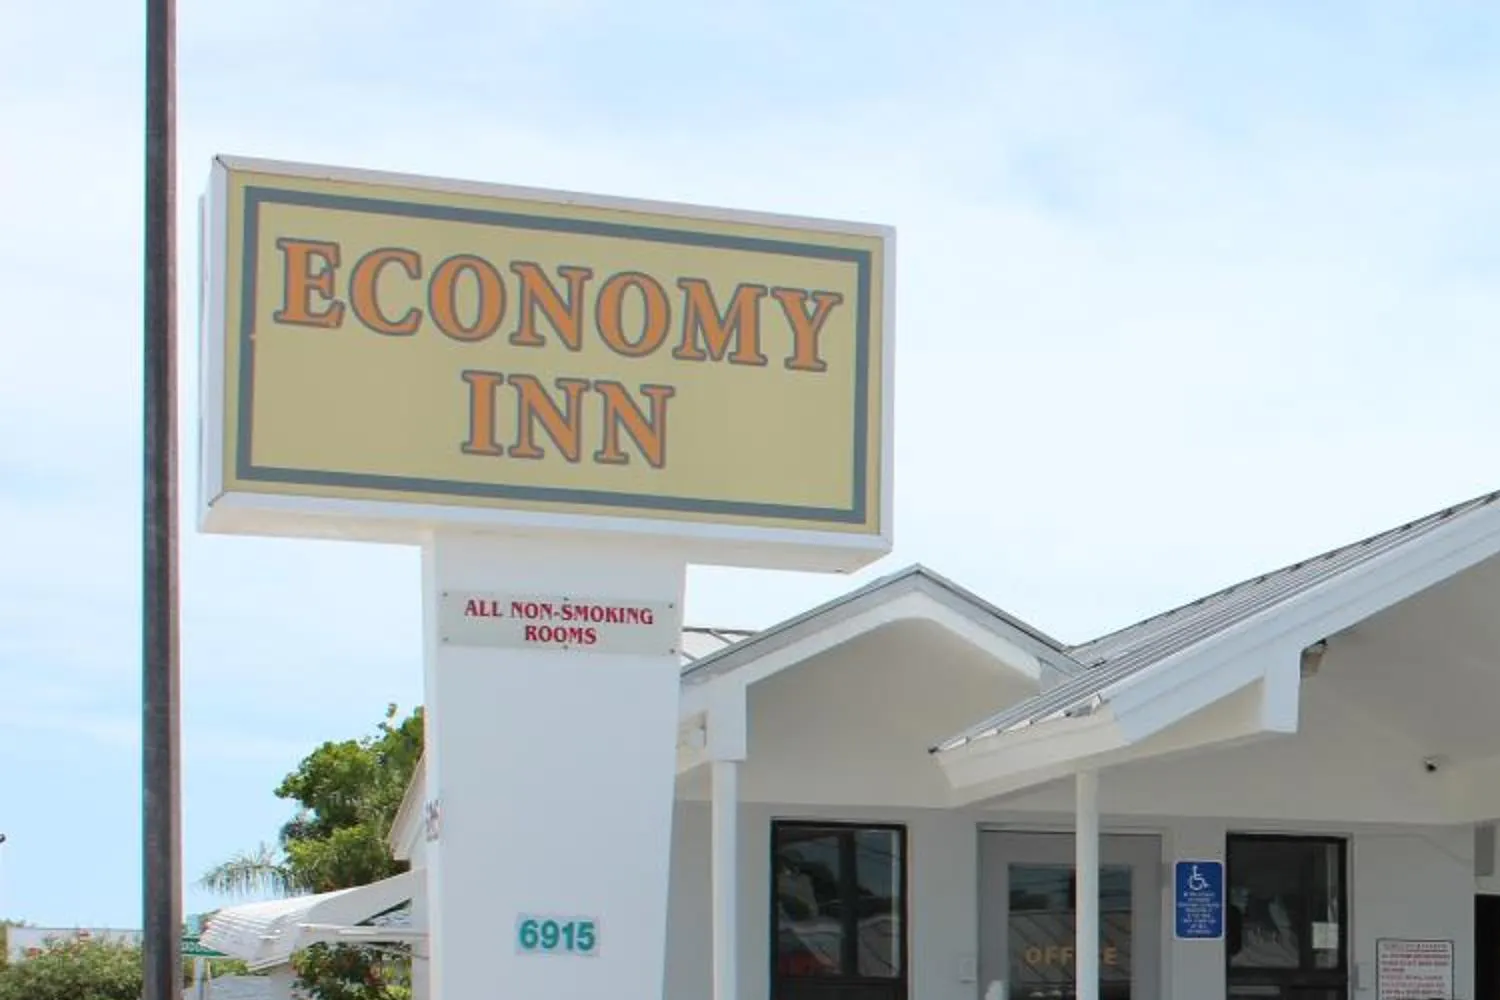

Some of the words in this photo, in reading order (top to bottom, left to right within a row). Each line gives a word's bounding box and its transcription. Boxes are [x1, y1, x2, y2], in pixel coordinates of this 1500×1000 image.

[273, 237, 844, 373] ECONOMY
[460, 369, 677, 469] INN
[464, 599, 503, 618] ALL
[510, 601, 654, 625] NON-SMOKING
[525, 625, 597, 645] ROOMS
[519, 919, 595, 951] 6915
[1025, 945, 1119, 966] OFFE
